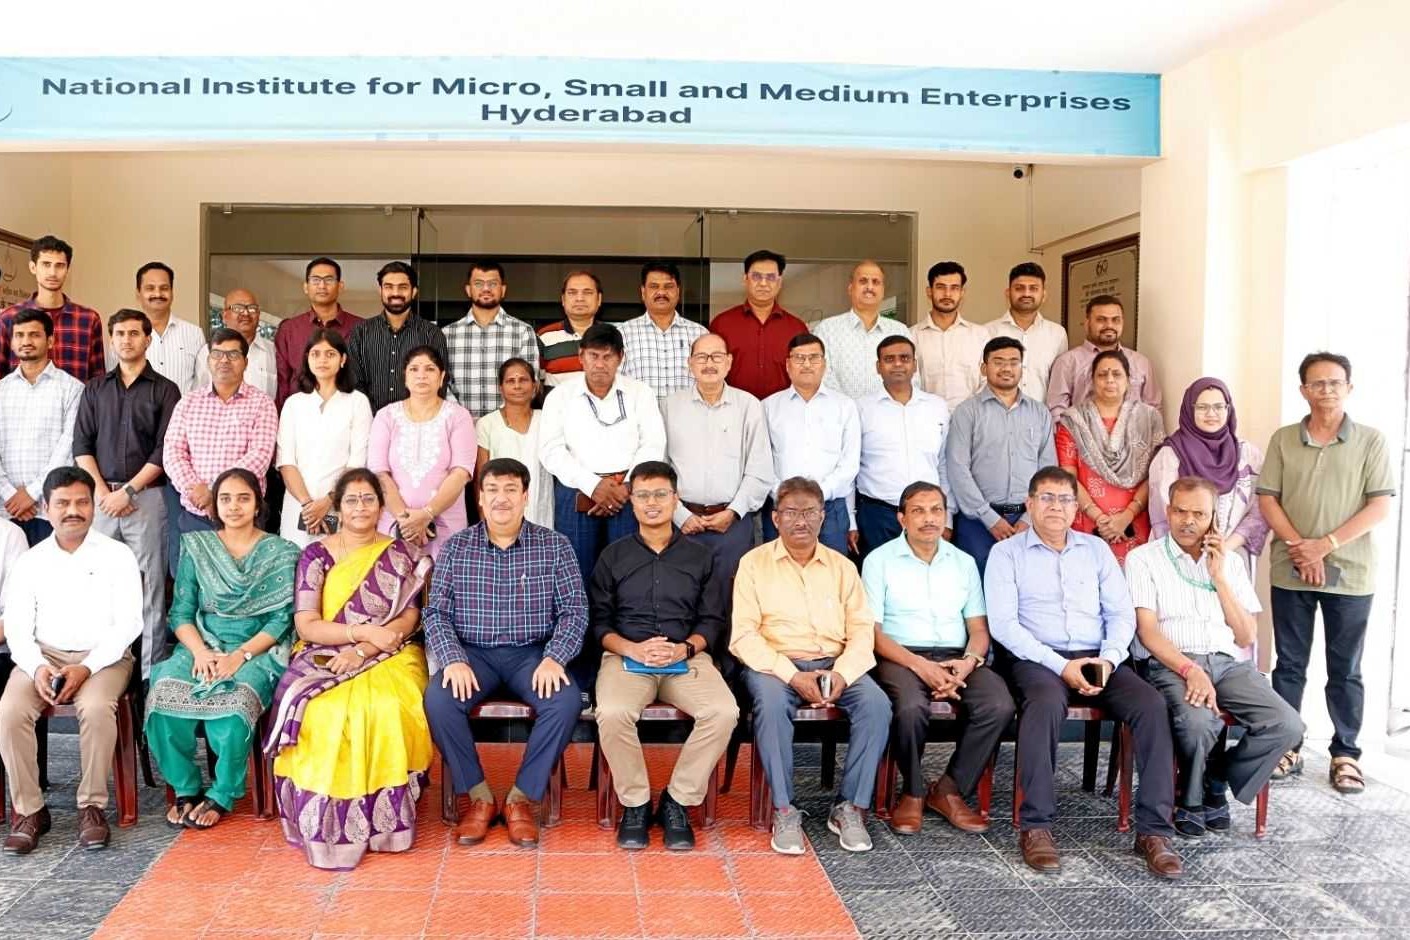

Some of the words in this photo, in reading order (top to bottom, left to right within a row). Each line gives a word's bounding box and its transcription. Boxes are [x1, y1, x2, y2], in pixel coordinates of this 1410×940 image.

[42, 77, 191, 95] National
[202, 77, 356, 95] Institute
[366, 77, 421, 95] for
[433, 77, 551, 100] Micro,
[564, 79, 667, 98] Small
[678, 82, 748, 99] and
[760, 83, 909, 104] Medium
[921, 87, 1131, 112] Enterprises
[482, 104, 692, 125] Hyderabad
